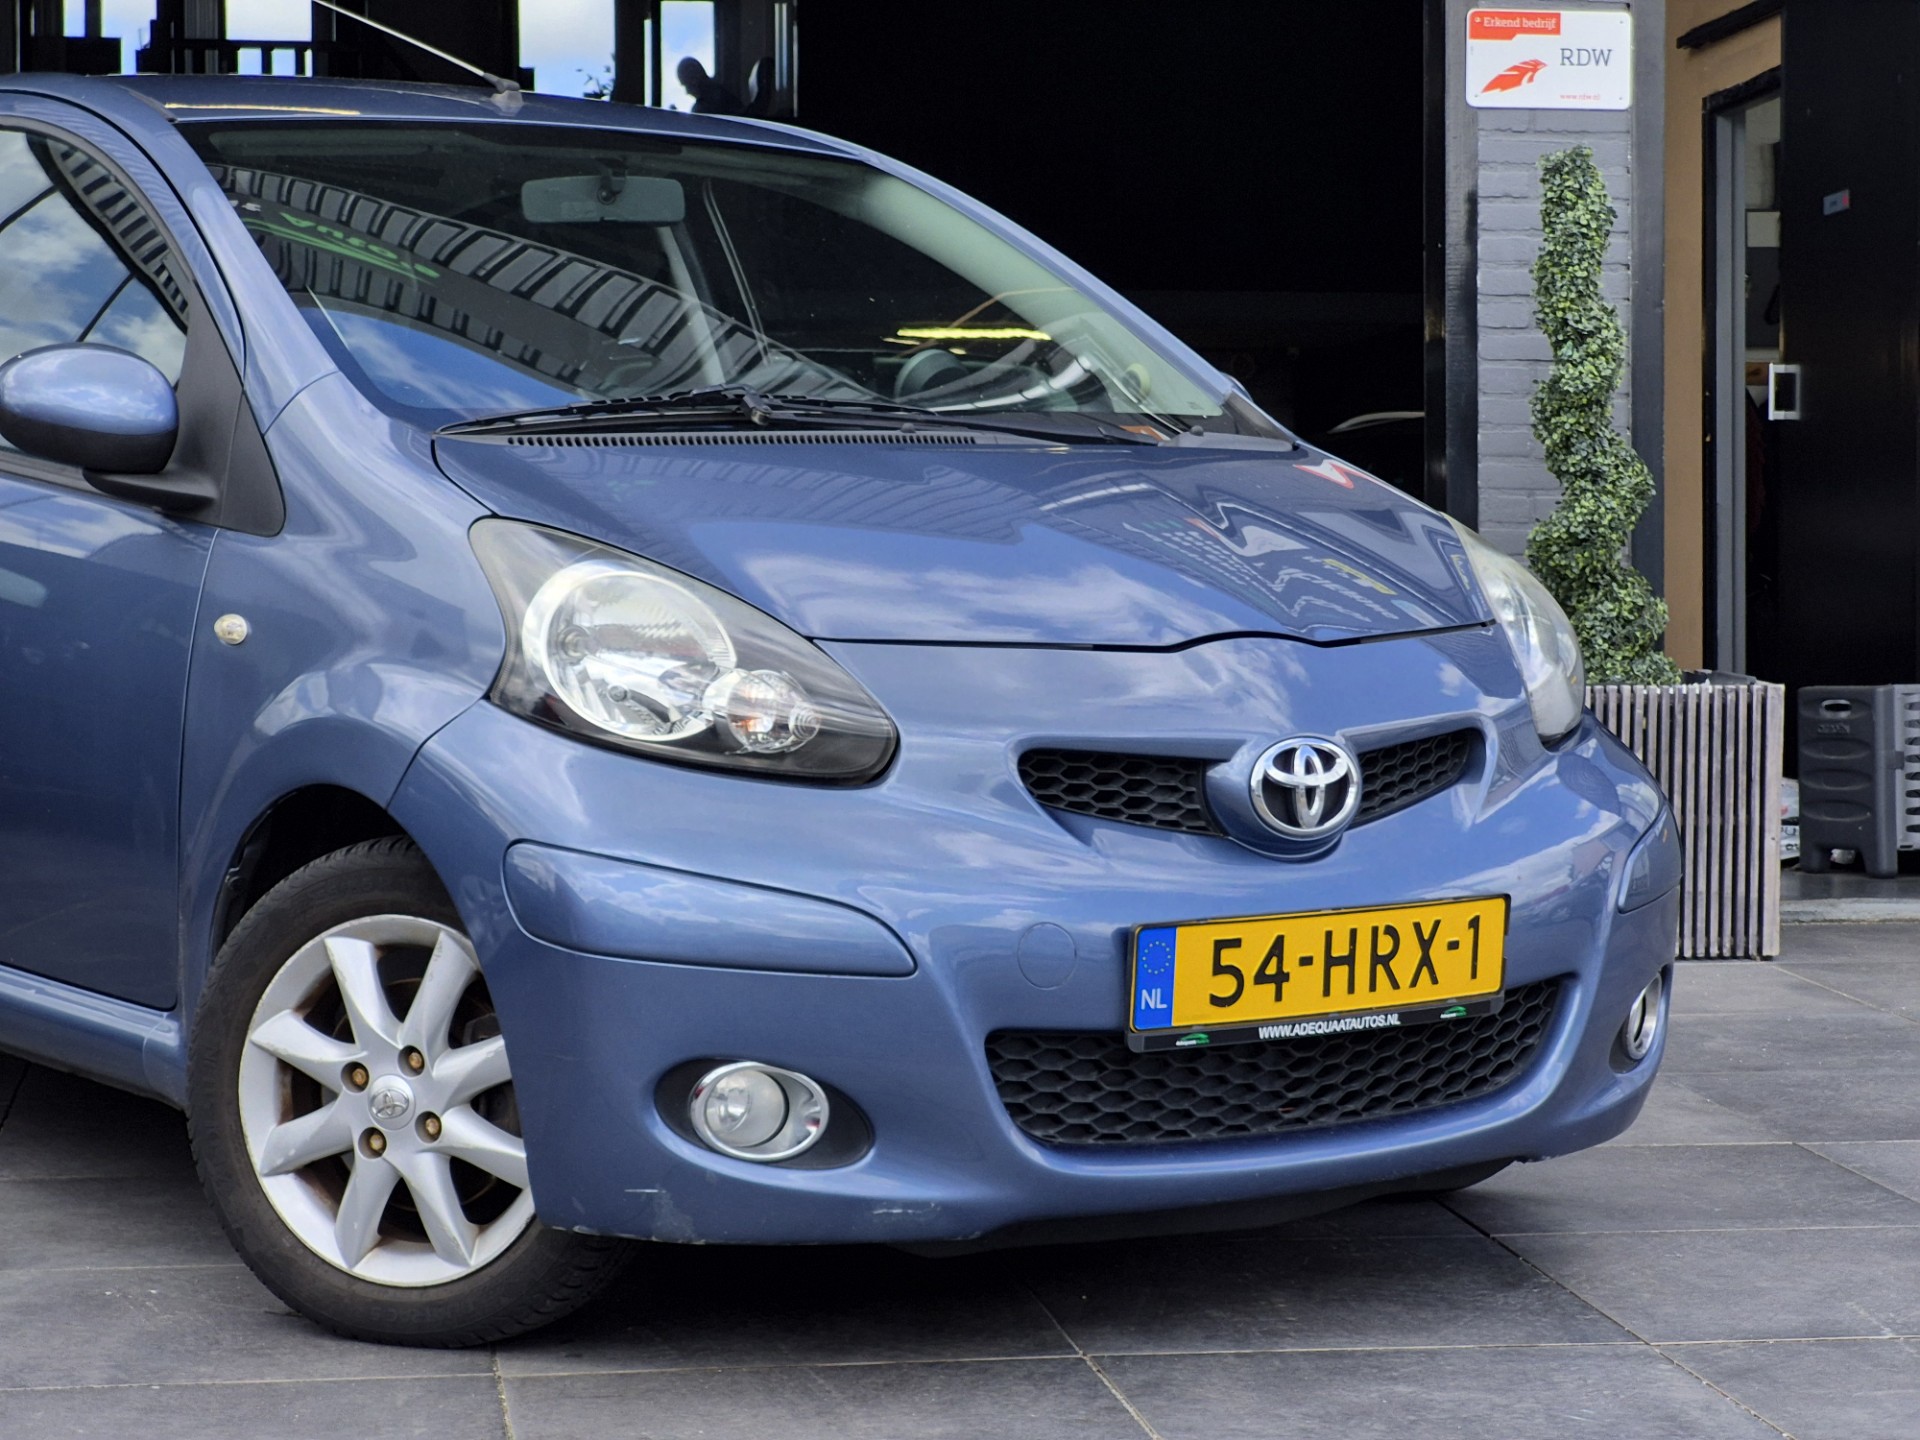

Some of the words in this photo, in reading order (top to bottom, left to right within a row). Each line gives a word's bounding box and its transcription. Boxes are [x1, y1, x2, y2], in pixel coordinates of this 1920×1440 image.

[1483, 17, 1520, 27] Erkend
[1522, 17, 1556, 30] bedrijf
[1560, 48, 1612, 66] RDW
[1208, 914, 1481, 1008] 54-HRX-1
[1141, 988, 1167, 1009] NL
[1258, 1013, 1401, 1039] WWW.ADEQUAATAUTOS.NL
